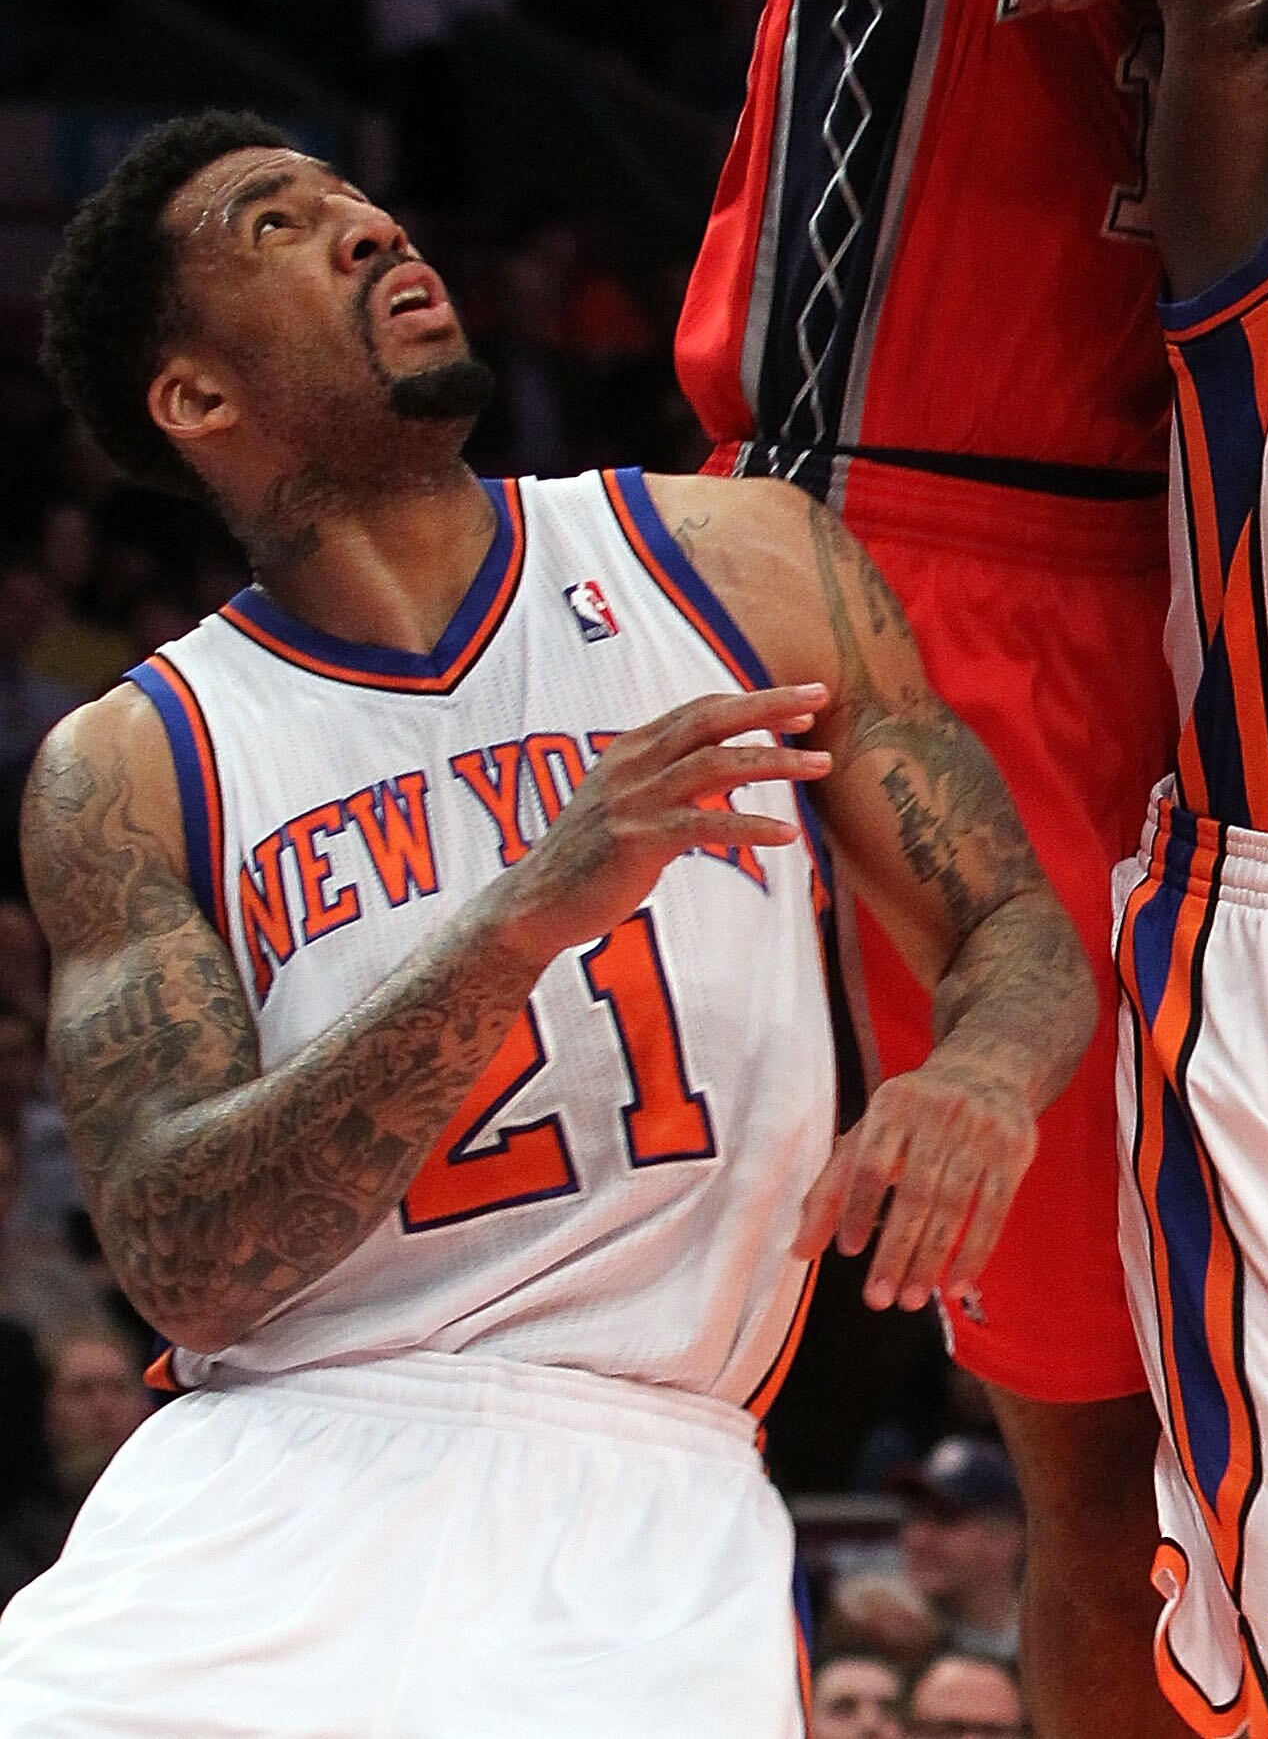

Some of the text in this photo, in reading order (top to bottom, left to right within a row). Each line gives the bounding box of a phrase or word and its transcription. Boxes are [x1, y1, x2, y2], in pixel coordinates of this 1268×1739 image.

[237, 768, 441, 1011] NEW
[448, 729, 768, 896] YO
[400, 905, 718, 1235] 21
